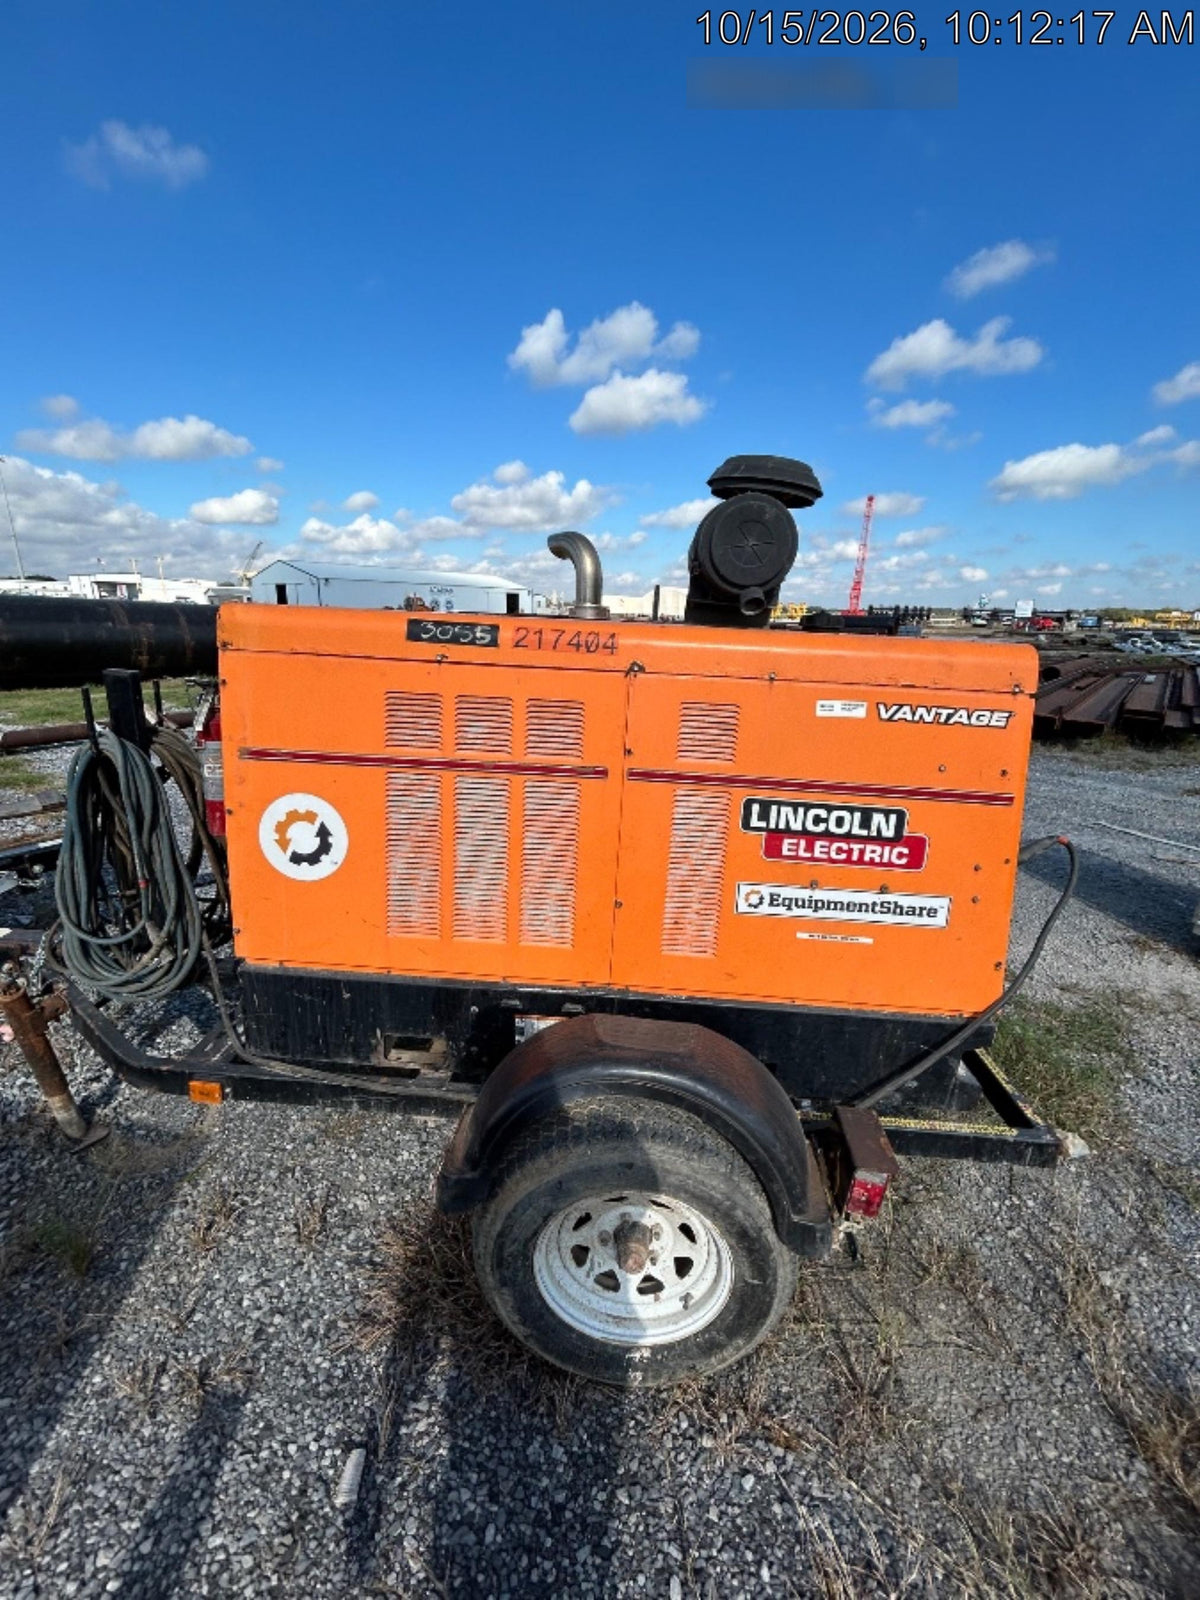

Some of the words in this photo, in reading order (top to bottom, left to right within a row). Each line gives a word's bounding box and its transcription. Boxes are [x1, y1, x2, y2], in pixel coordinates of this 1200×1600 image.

[513, 627, 619, 655] 217404
[877, 702, 1011, 728] VANTAGE
[749, 802, 898, 838] LINCOLN
[781, 838, 909, 866] ELECTRIC
[767, 893, 939, 918] EquipmentShare
